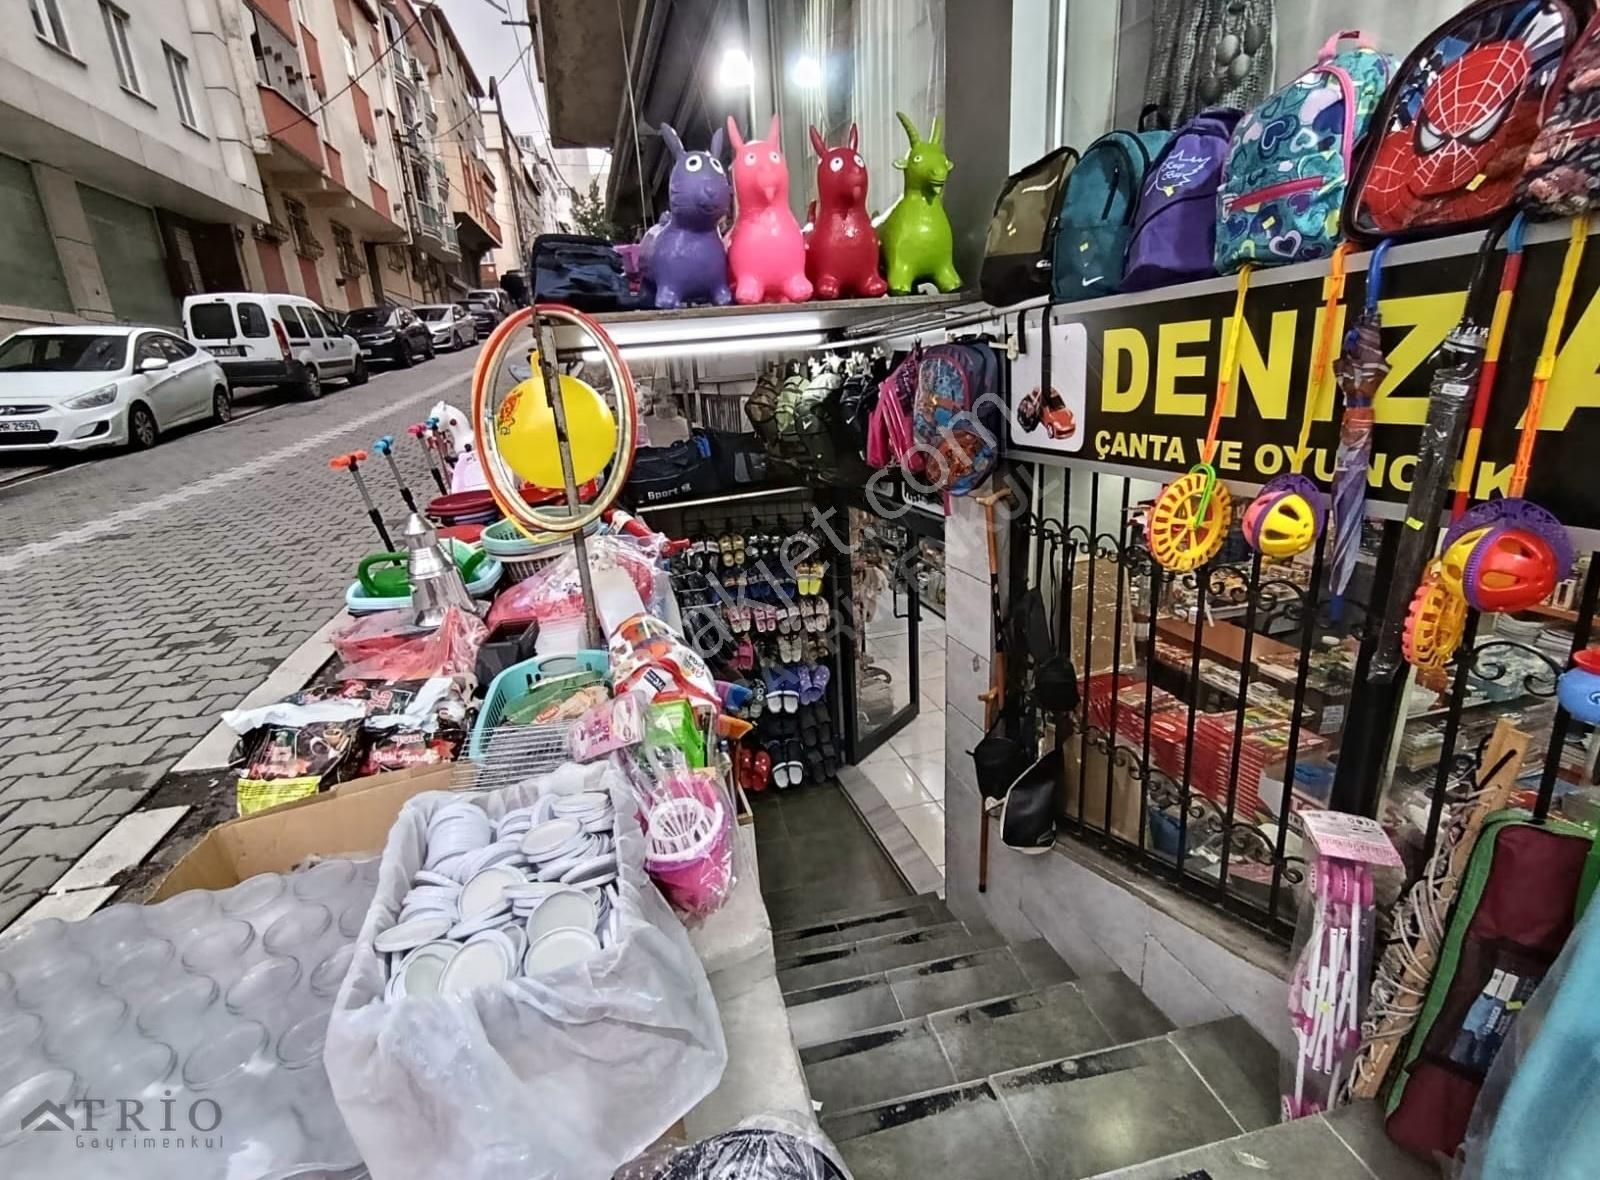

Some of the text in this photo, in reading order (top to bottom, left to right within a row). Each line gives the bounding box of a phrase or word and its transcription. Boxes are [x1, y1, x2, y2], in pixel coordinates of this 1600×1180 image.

[1099, 275, 1470, 426] DENİZ
[1095, 430, 1516, 499] ÇANTA VE OYUNCK
